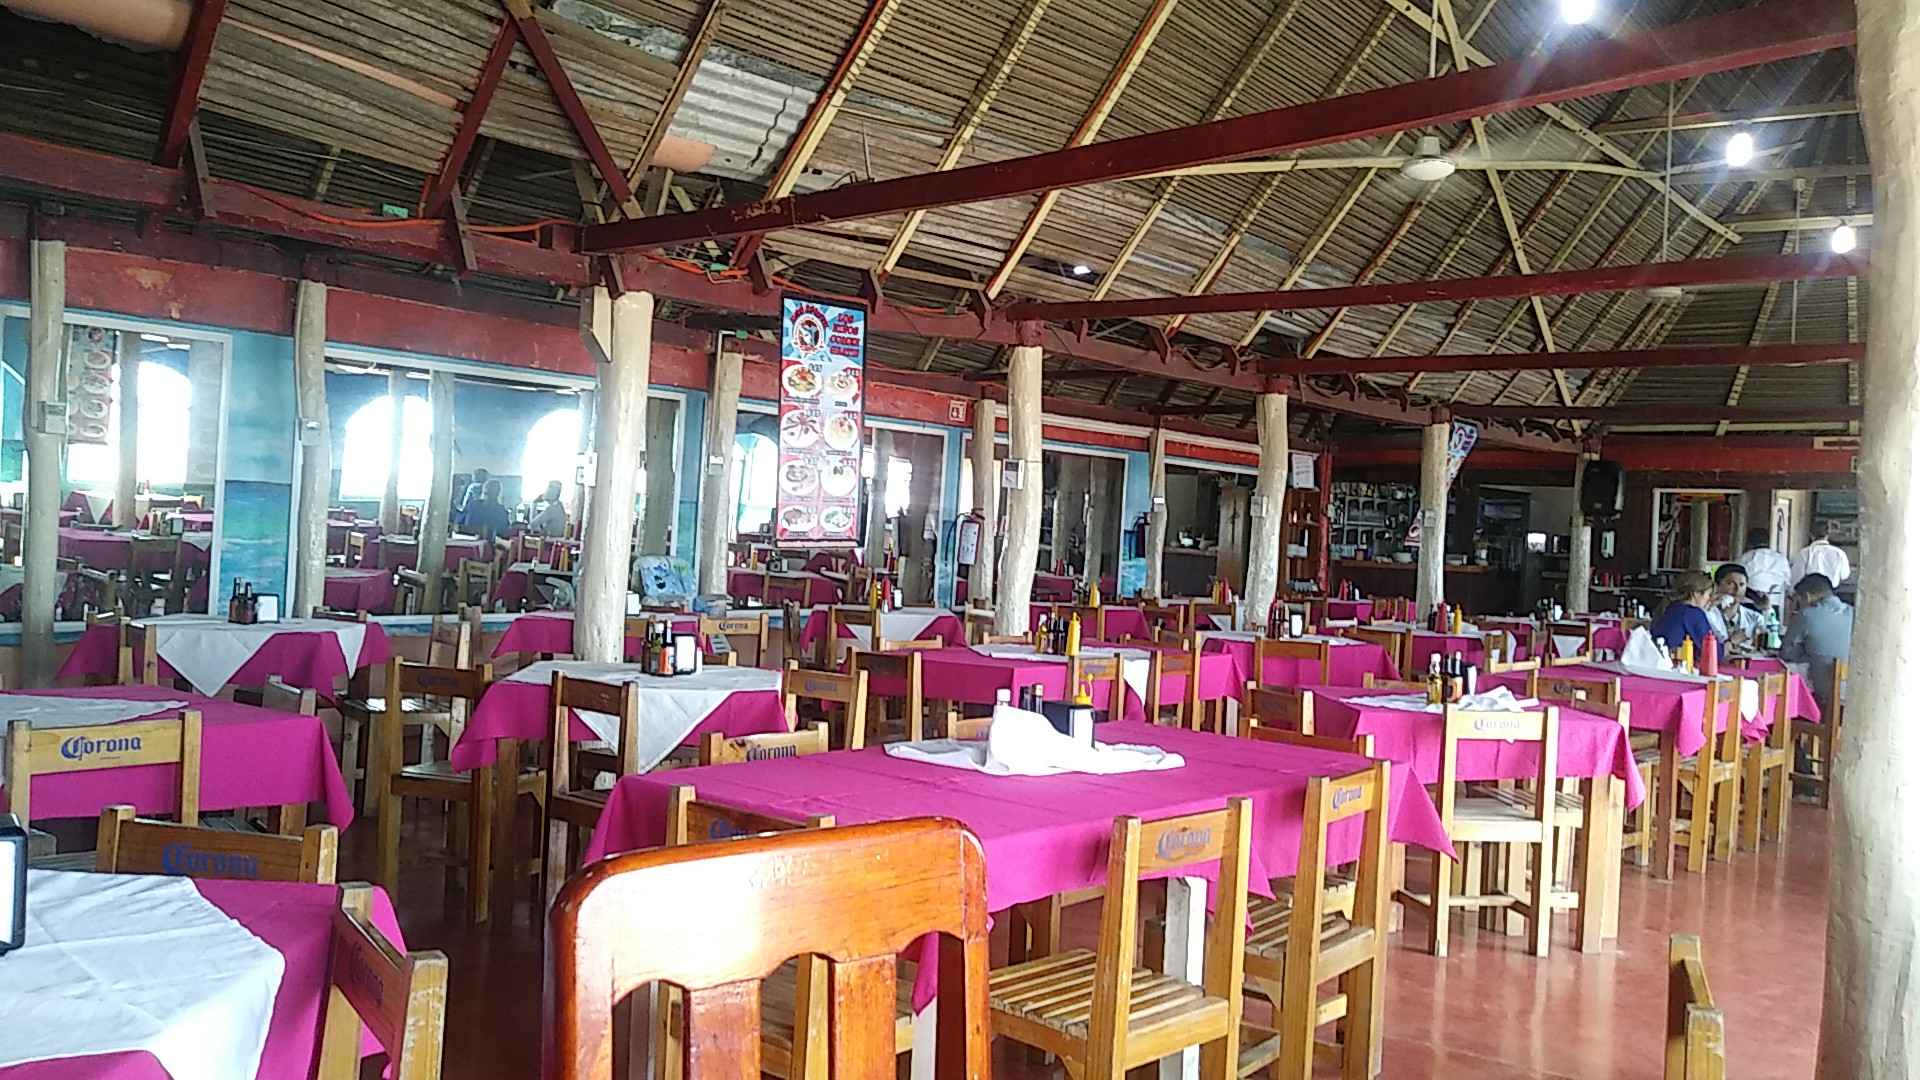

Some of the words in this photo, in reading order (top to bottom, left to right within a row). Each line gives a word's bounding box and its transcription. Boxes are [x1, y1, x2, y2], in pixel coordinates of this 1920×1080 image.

[719, 622, 748, 632] Corona
[1474, 717, 1520, 732] Corona
[61, 735, 142, 762] Corona
[1332, 786, 1362, 810] Corona
[1157, 828, 1211, 859] Corona
[162, 840, 258, 877] Corona
